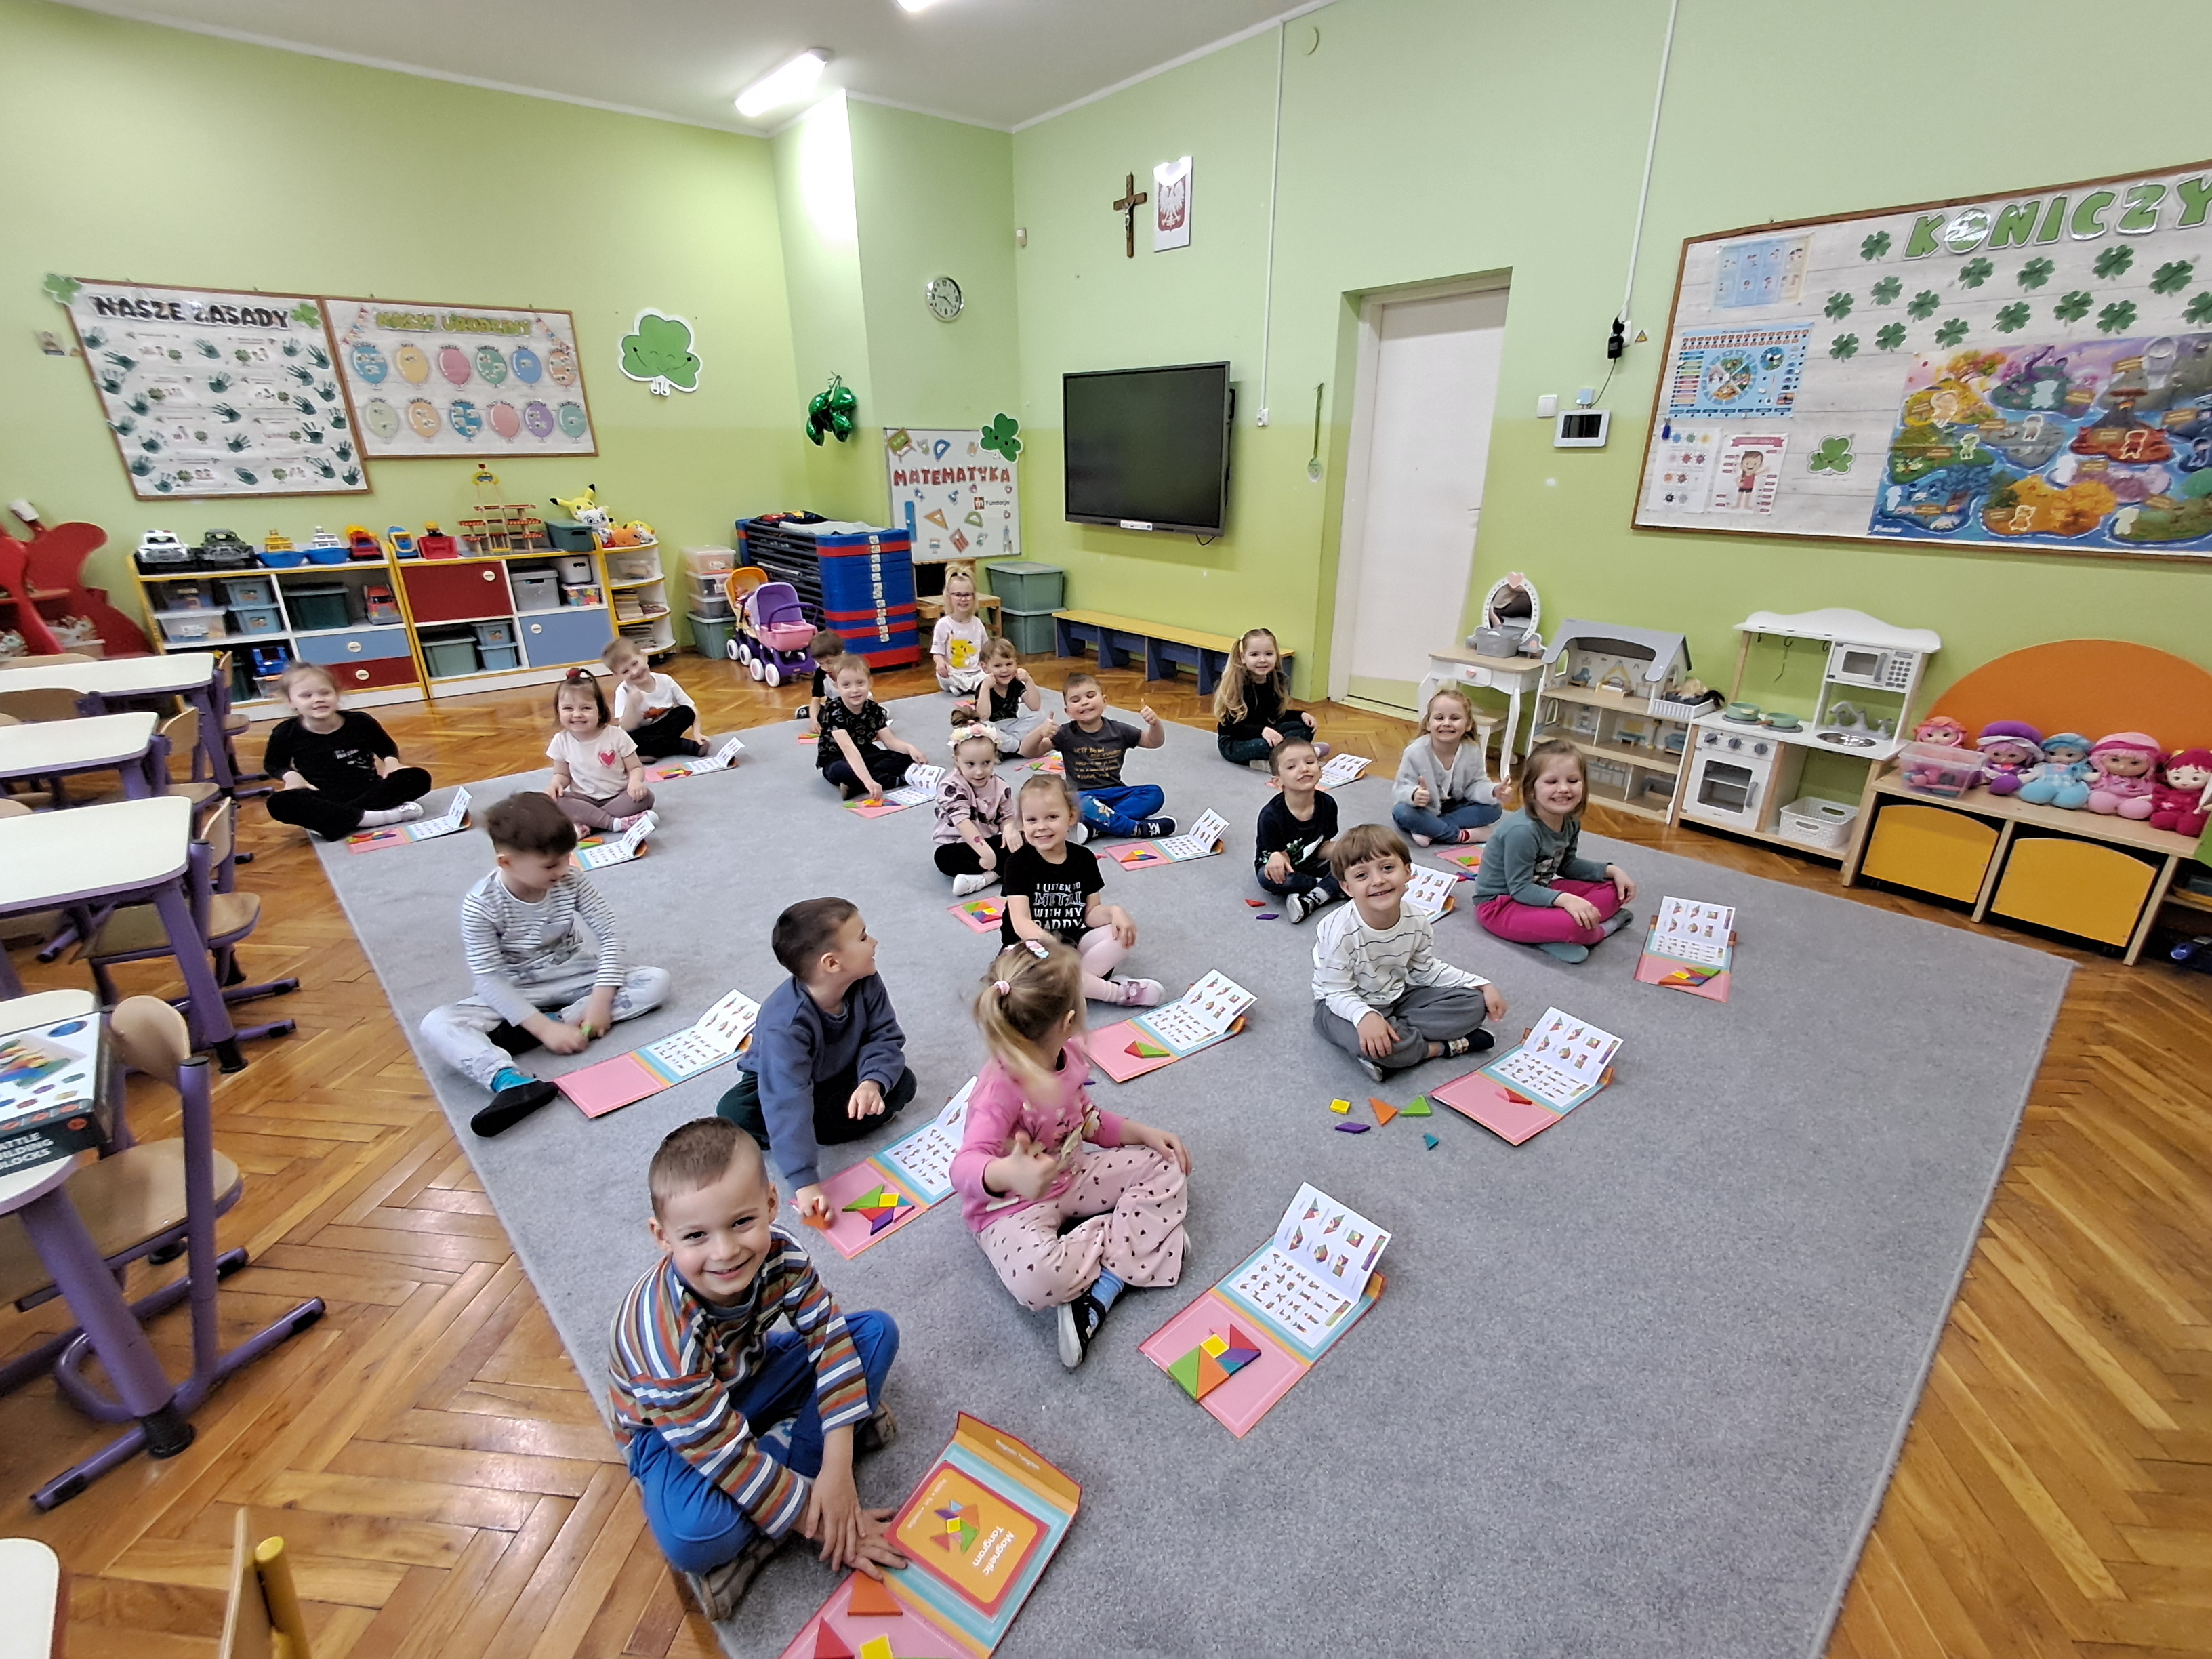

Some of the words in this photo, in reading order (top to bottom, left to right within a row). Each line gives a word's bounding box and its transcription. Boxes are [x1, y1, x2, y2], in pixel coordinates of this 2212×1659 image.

[91, 296, 186, 321] NASZE
[893, 466, 1011, 487] MATEMATYKA
[1043, 883, 1071, 893] LISTEN
[1073, 882, 1081, 890] TO
[1034, 908, 1061, 918] WITH
[1065, 907, 1083, 918] MY
[972, 1525, 1004, 1567] Tangram
[982, 1530, 1015, 1576] Magnetic
